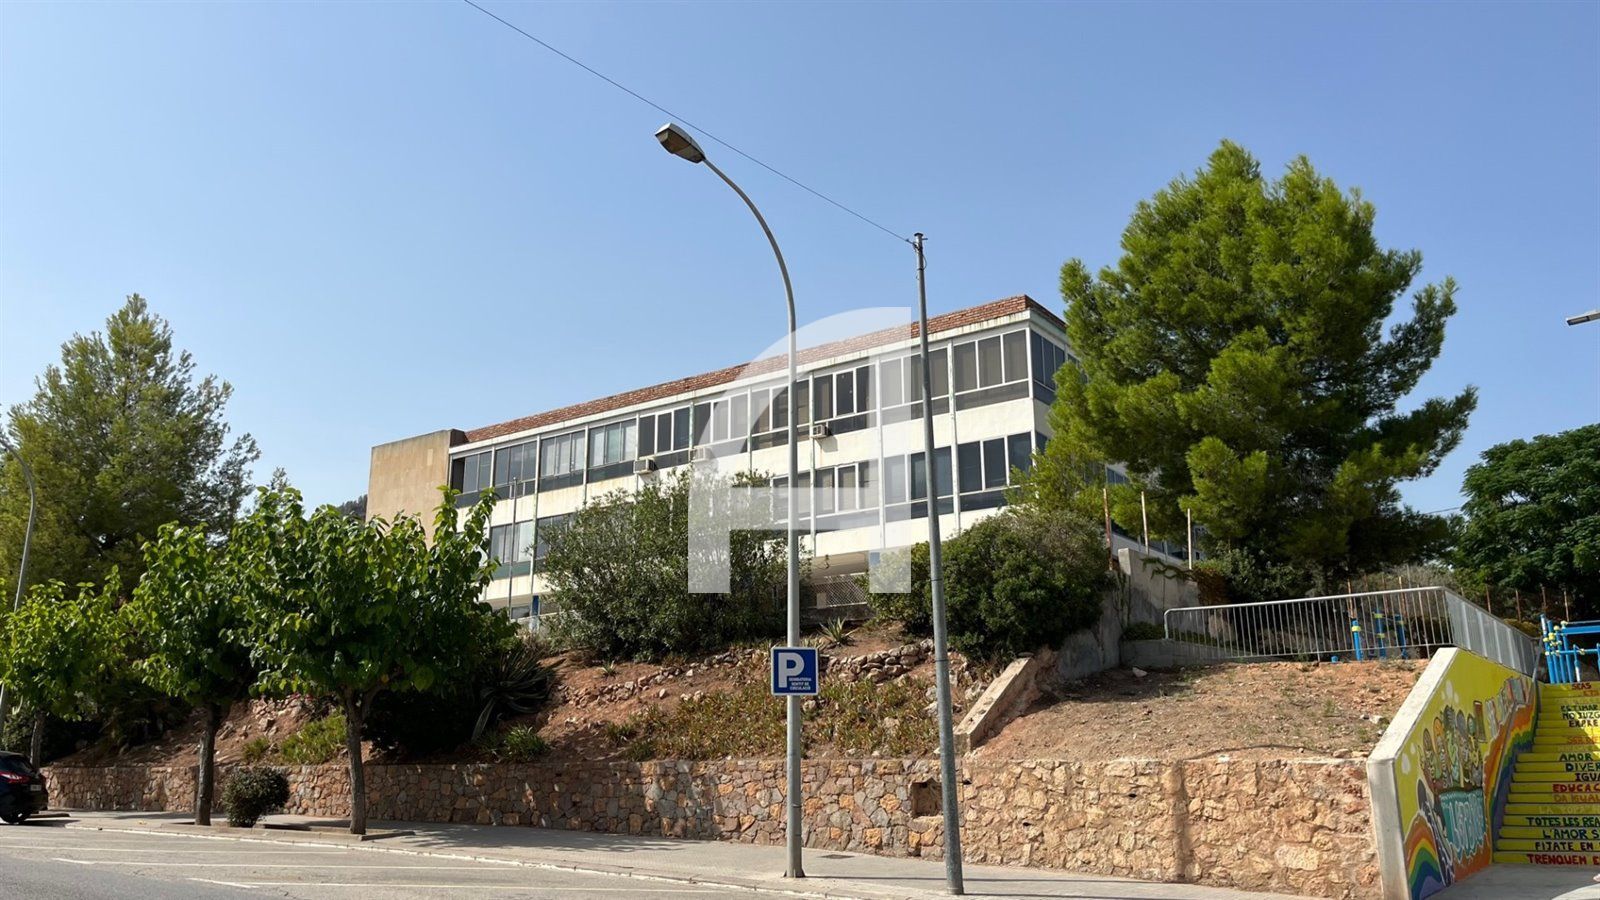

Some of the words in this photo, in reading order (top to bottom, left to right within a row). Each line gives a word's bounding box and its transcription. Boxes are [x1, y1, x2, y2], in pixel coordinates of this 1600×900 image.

[778, 652, 805, 688] P
[1562, 712, 1576, 720] NO
[1559, 753, 1594, 762] AMOR
[1525, 816, 1560, 827] TOTES
[1563, 816, 1580, 827] LES
[1543, 828, 1588, 840] L'AMOR
[1535, 841, 1574, 851] FIJATE
[1580, 841, 1593, 851] EN
